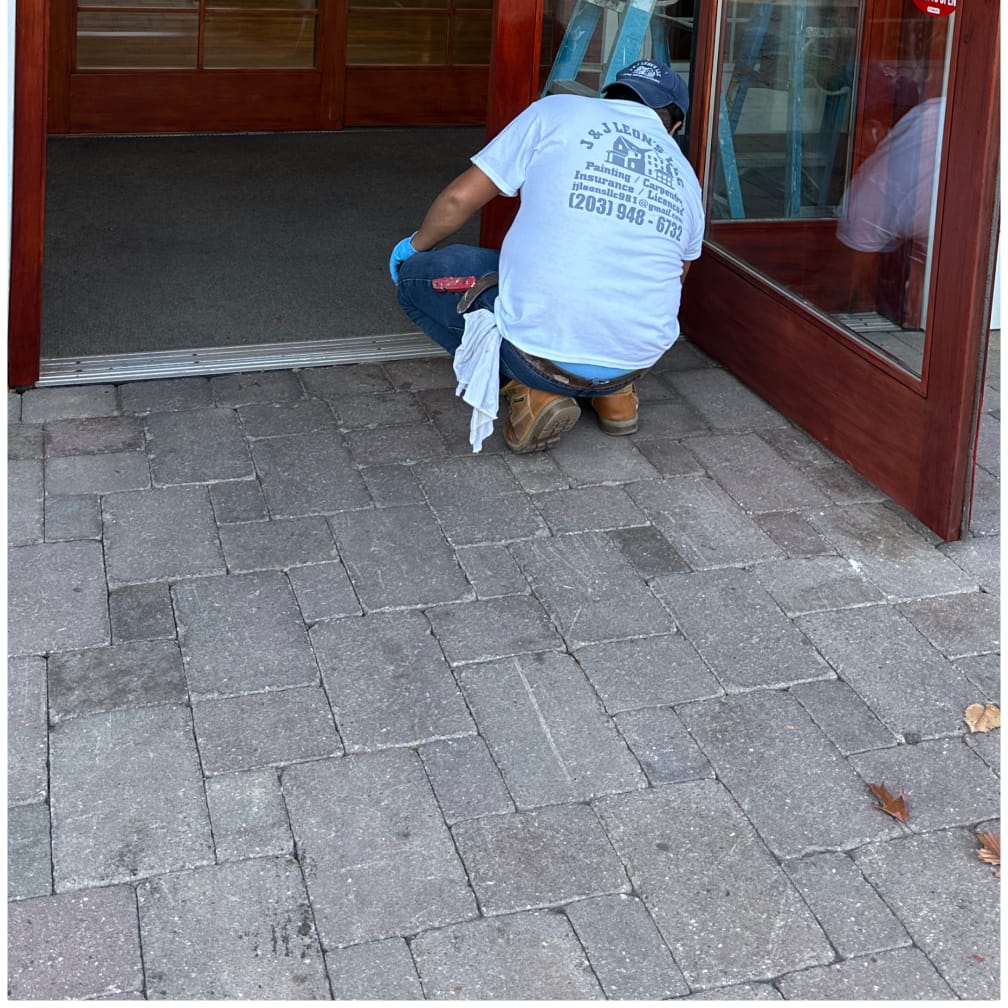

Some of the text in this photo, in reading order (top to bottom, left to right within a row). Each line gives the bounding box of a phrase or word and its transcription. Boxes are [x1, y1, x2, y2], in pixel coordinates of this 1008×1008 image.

[579, 138, 594, 150] J
[587, 128, 604, 140] &
[601, 122, 612, 134] J
[573, 169, 635, 194] Insurance
[584, 160, 631, 183] Painting
[568, 192, 614, 217] (203)
[616, 202, 646, 226] 948
[656, 215, 684, 242] 6732
